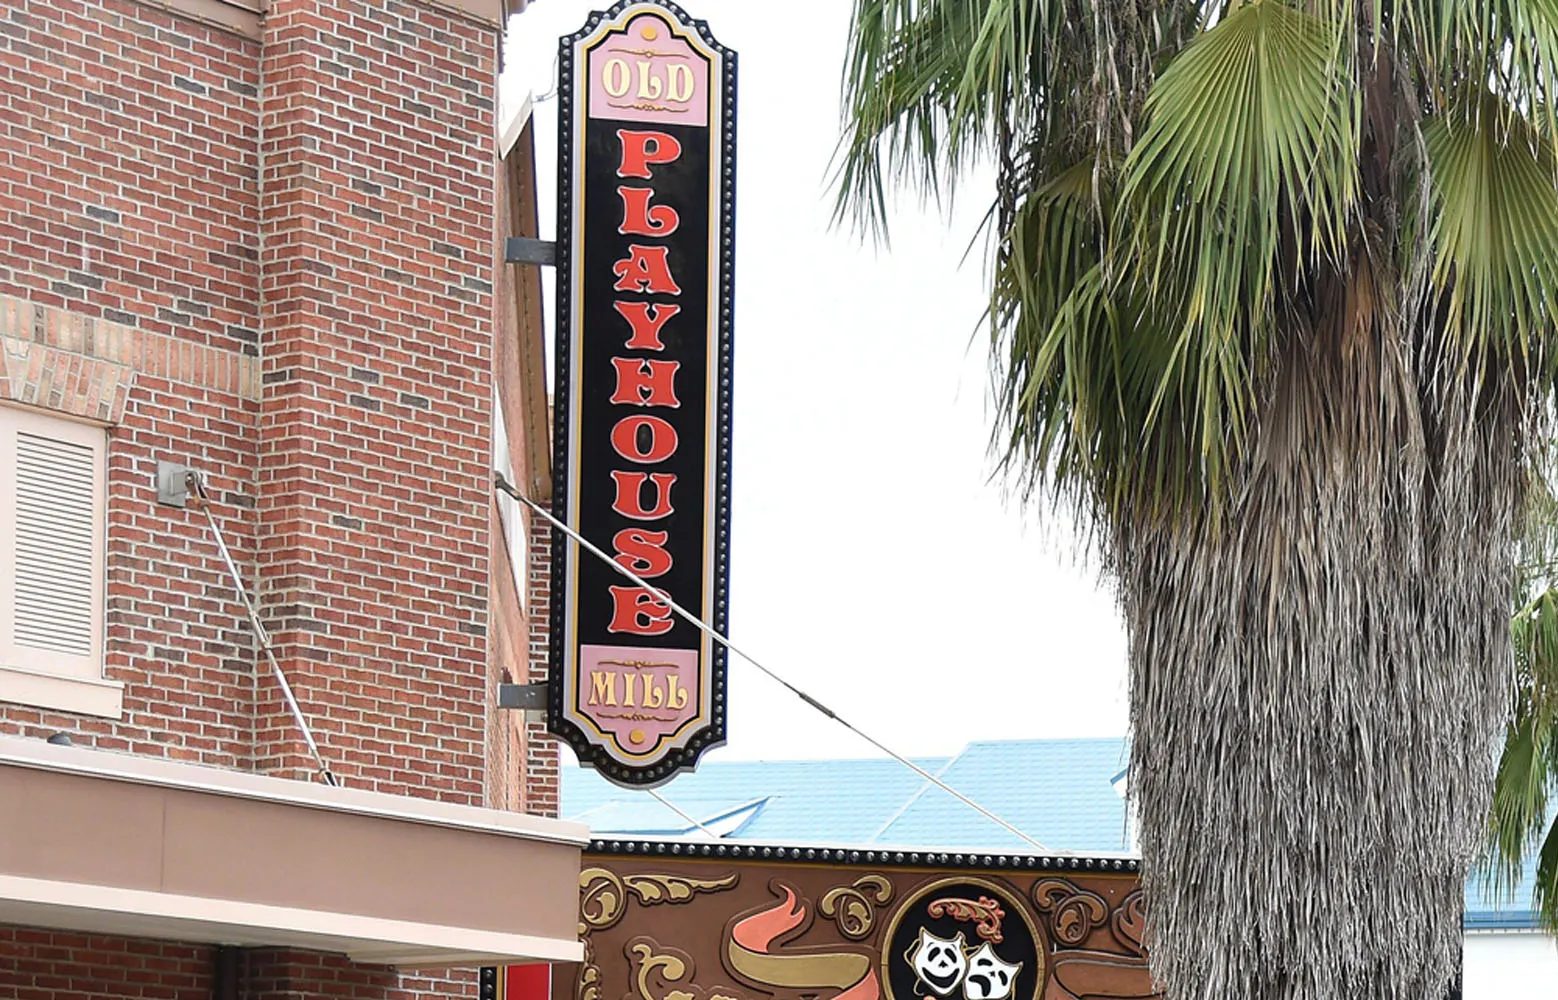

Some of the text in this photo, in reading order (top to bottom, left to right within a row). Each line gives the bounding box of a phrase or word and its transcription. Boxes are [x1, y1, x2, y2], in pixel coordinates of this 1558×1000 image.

[602, 57, 695, 103] OLD
[608, 128, 682, 635] PLAYHOUSE
[588, 669, 689, 710] MILL
